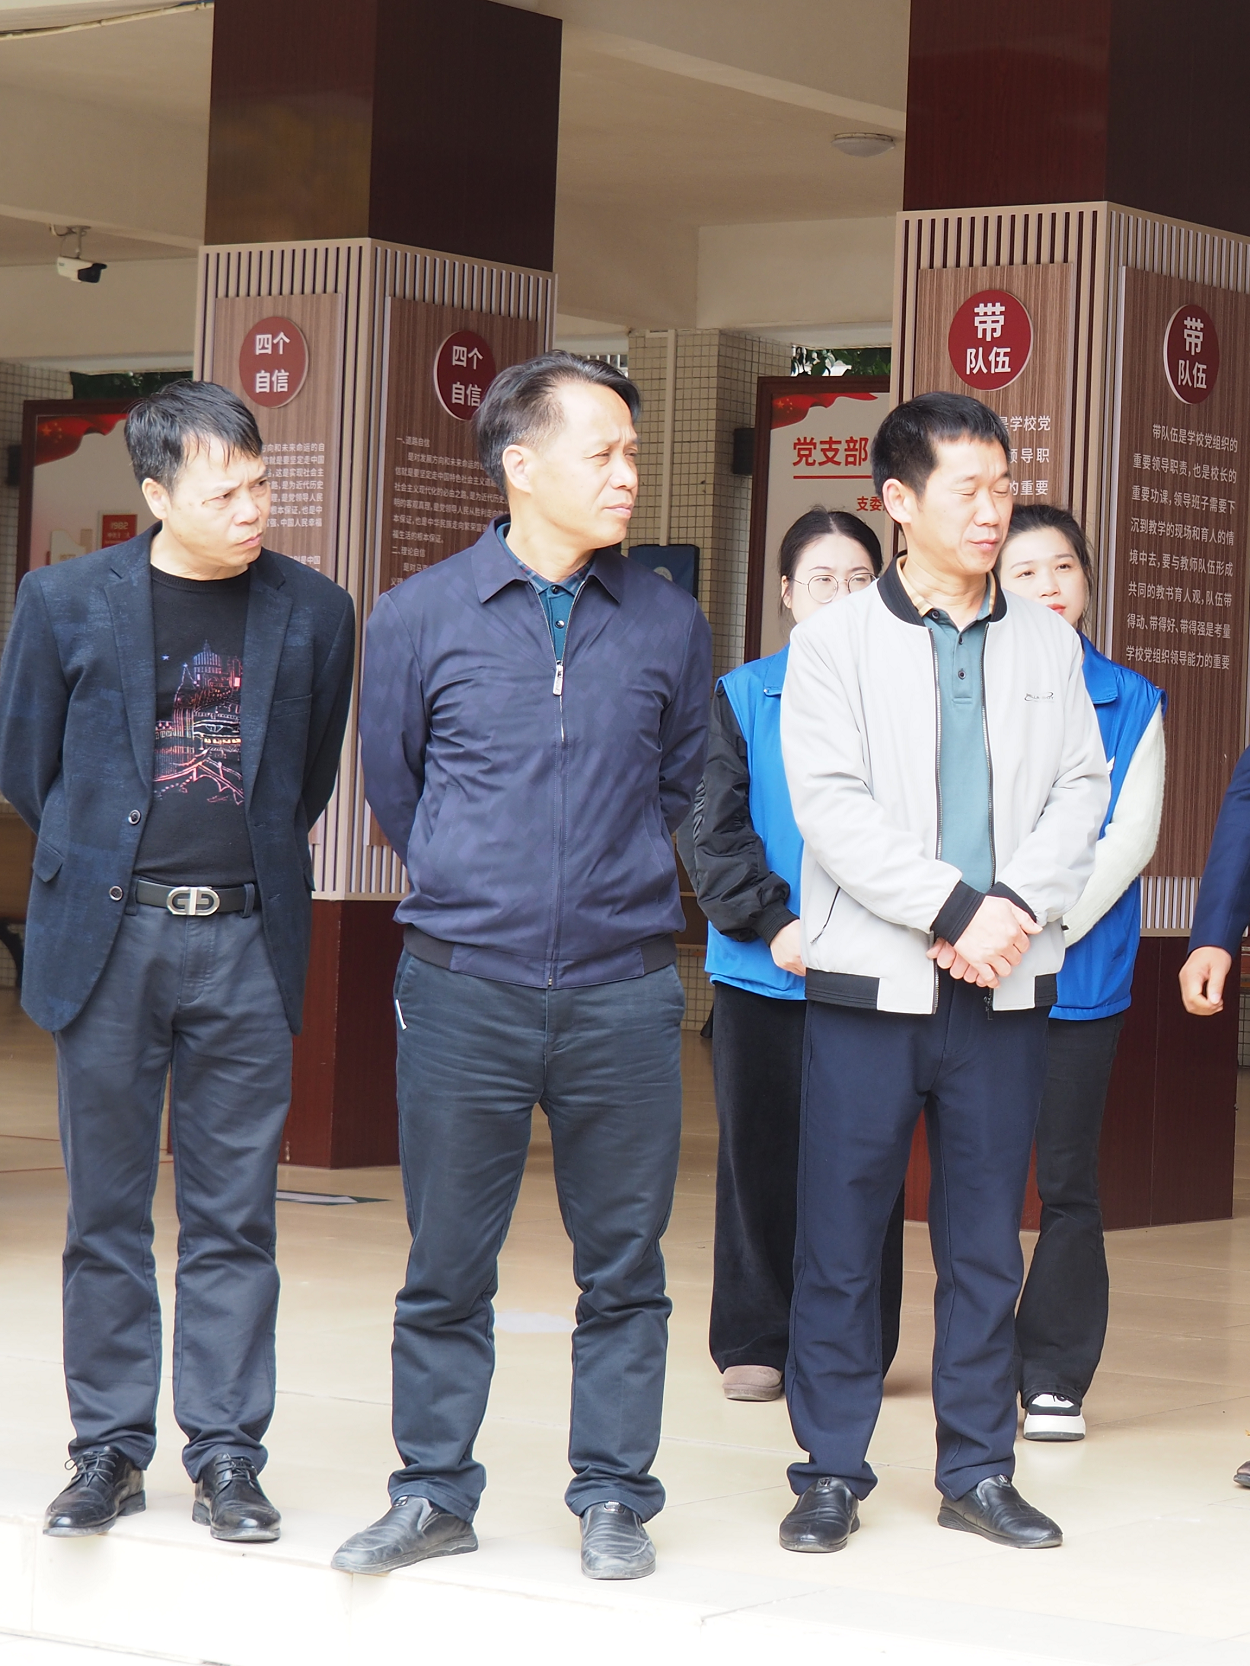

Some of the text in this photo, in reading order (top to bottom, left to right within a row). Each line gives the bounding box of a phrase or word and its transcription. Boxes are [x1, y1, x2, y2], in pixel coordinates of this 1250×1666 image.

[974, 302, 1005, 342] 带
[1184, 316, 1204, 356] 带
[255, 331, 290, 355] 四个
[452, 345, 483, 370] 四个
[966, 347, 1011, 375] 队伍
[254, 369, 289, 394] 自信
[1177, 360, 1207, 389] 队伍
[451, 382, 481, 407] 自信
[792, 436, 869, 466] 党支部
[1152, 423, 1238, 453] 带队伍是学校党组织的
[1130, 517, 1235, 546] 沉到教学的现场和育人的情
[1125, 645, 1230, 670] 学校党组织领导能力的重要
